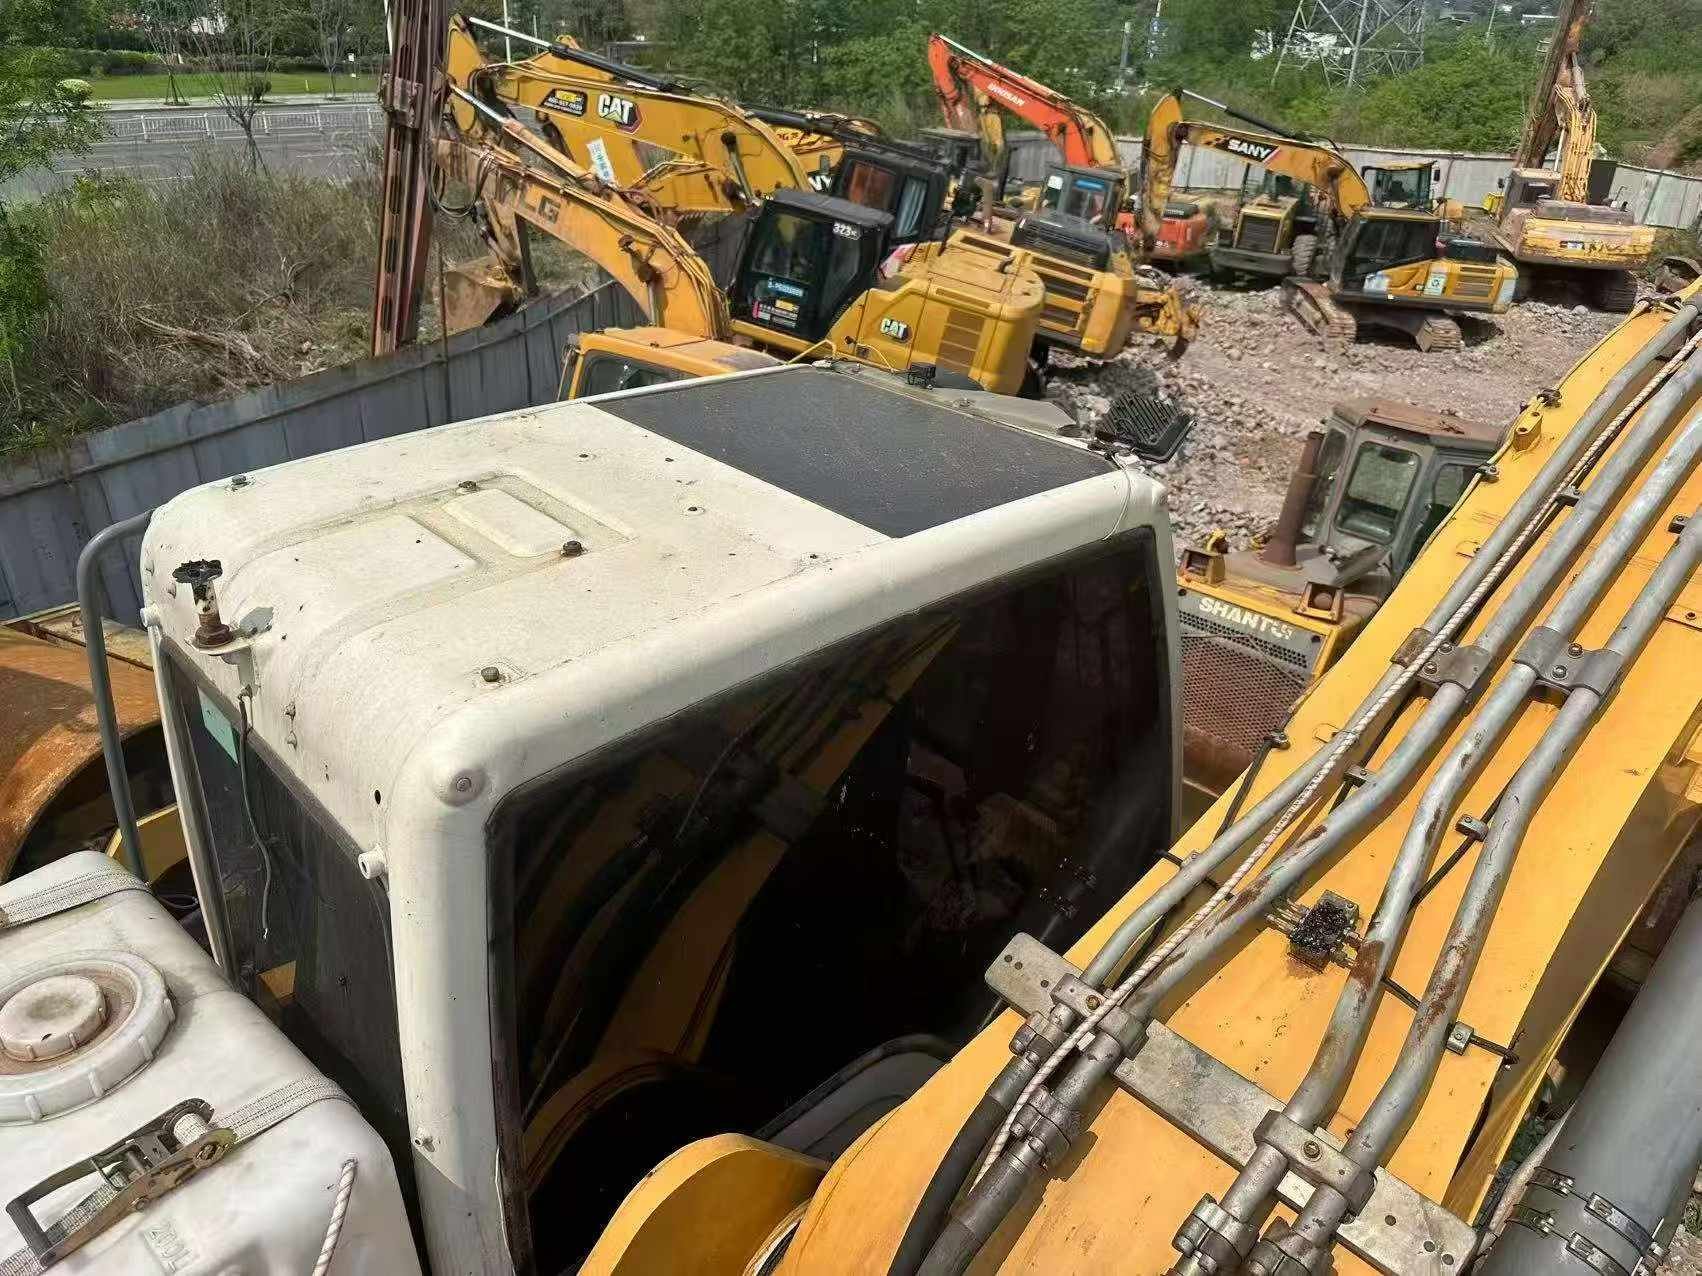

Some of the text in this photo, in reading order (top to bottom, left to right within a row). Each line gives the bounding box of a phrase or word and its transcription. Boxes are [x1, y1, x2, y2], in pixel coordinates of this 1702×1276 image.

[598, 93, 634, 125] CAT
[1227, 139, 1272, 159] SANY
[880, 318, 907, 339] CAT
